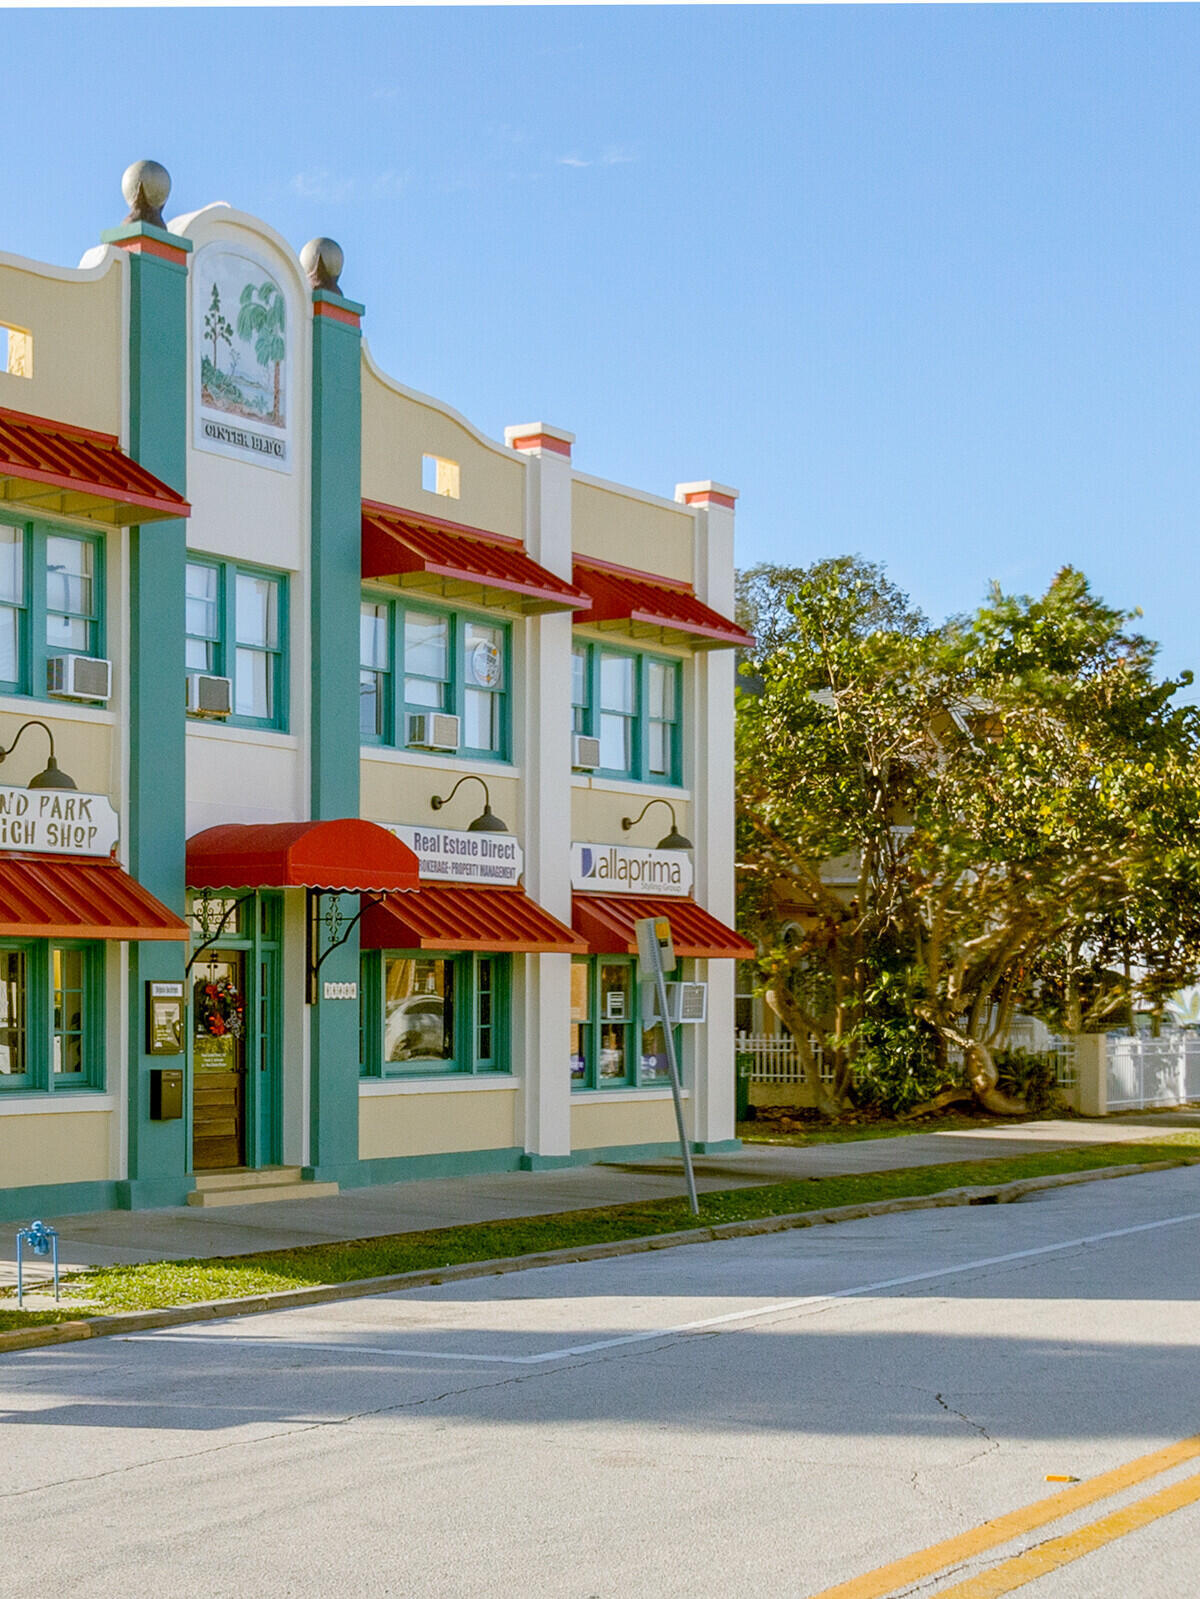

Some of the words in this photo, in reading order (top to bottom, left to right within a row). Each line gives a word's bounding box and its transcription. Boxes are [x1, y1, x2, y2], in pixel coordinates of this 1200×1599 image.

[205, 424, 250, 448] GINTER
[40, 795, 93, 822] PARK
[46, 823, 98, 849] SHOP
[414, 832, 440, 853] Real
[443, 836, 478, 856] Estate
[481, 839, 516, 860] Direct
[480, 864, 517, 879] MANAGEMENT
[598, 848, 681, 889] allaprima
